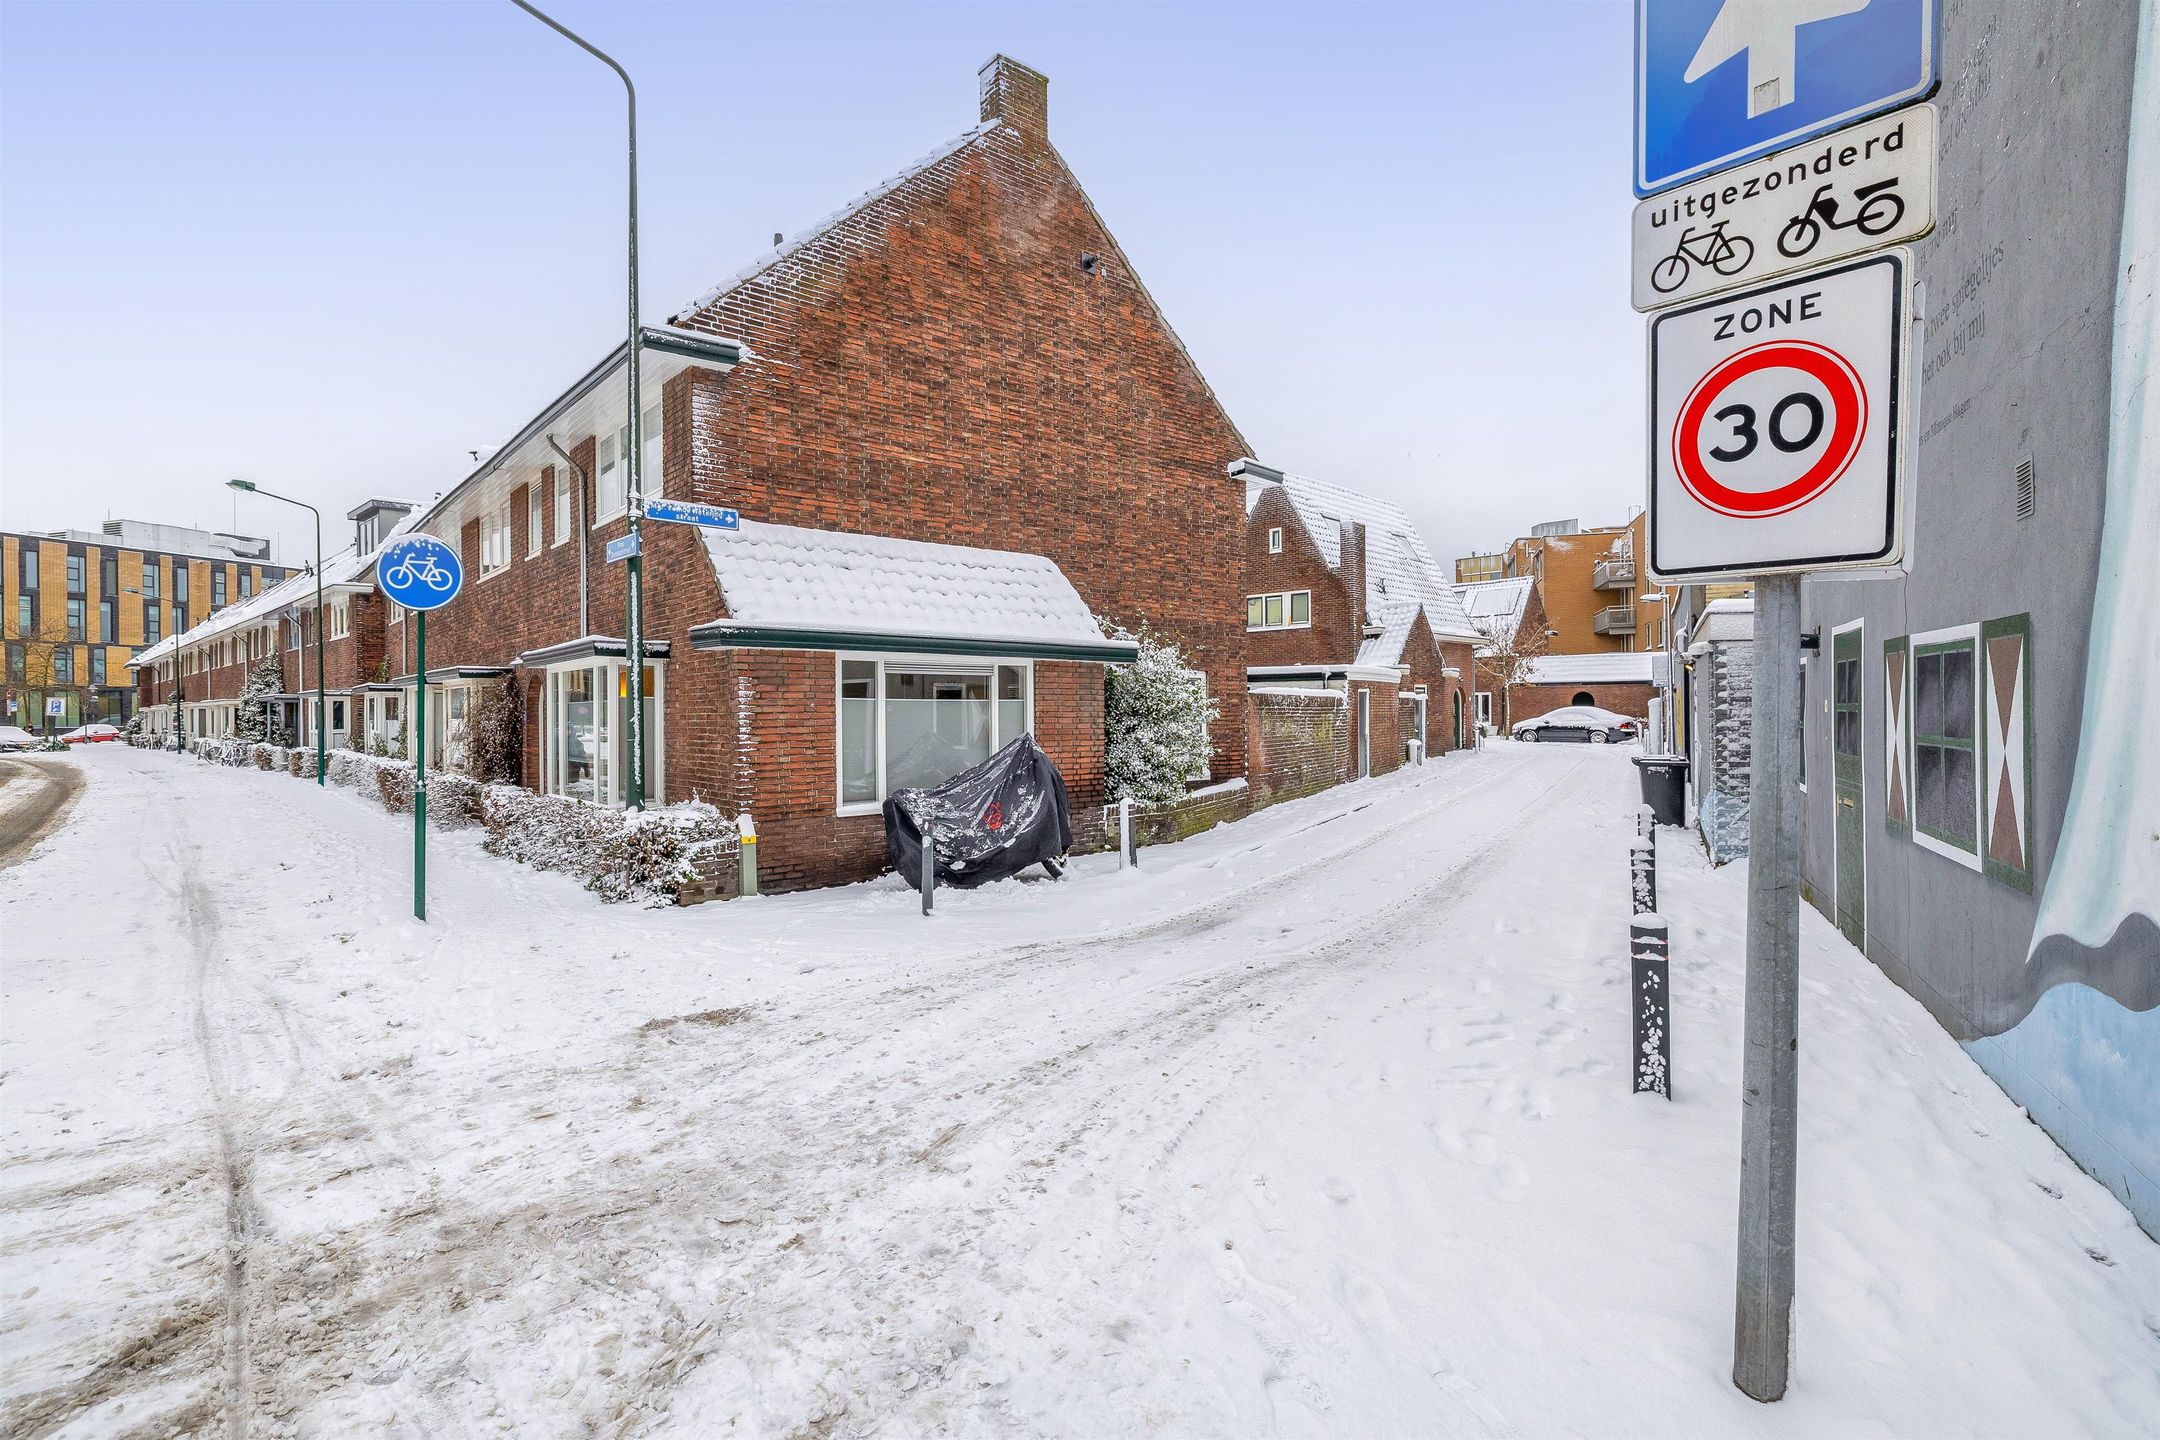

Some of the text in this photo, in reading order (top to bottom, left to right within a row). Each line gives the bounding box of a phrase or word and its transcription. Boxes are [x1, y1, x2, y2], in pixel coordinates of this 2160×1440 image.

[1651, 123, 1904, 228] uitgezonderd
[1713, 291, 1822, 341] ZONE
[1930, 303, 1949, 338] twee
[1952, 239, 2003, 316] spiegeltjes
[1936, 335, 1951, 373] ook
[1953, 318, 1965, 355] bij
[1968, 299, 1984, 342] mij
[1709, 392, 1825, 463] 30
[676, 514, 699, 522] straat
